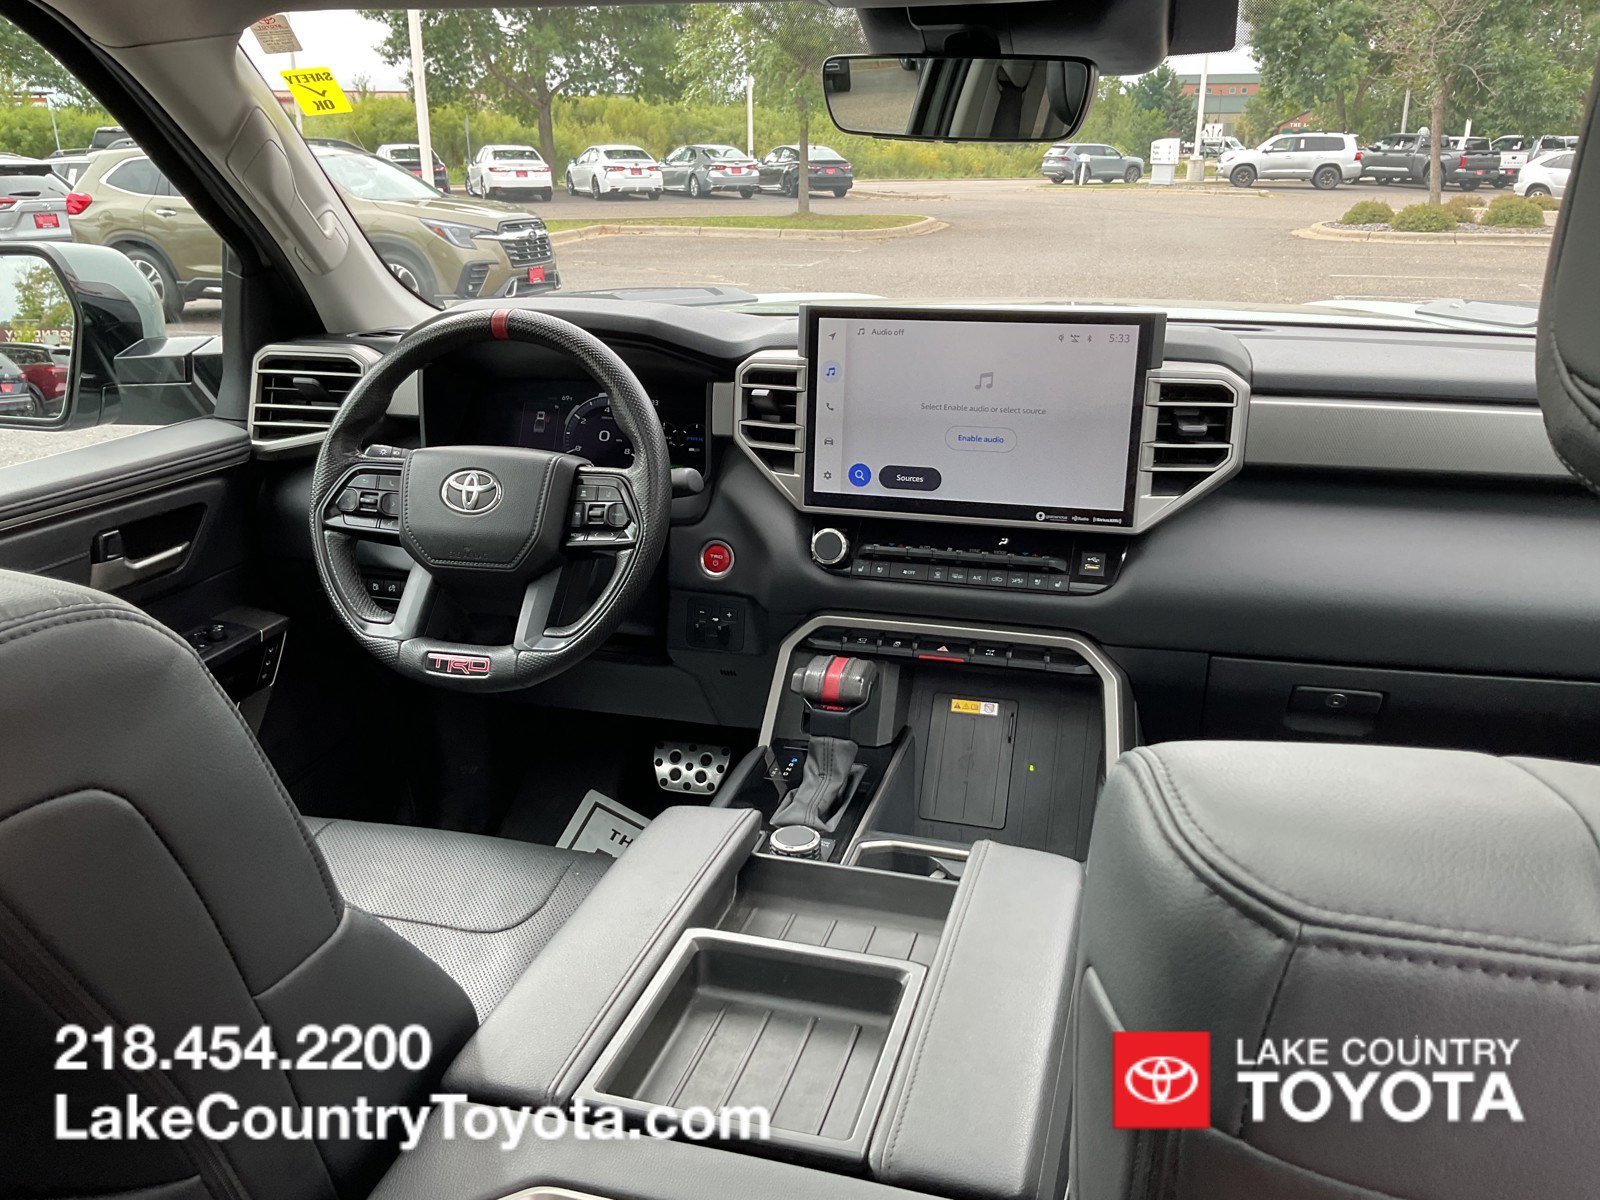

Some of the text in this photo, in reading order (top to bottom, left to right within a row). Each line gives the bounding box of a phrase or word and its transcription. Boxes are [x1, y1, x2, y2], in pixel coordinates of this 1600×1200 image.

[871, 328, 905, 336] Audio off
[1108, 333, 1131, 343] 5:33
[920, 402, 942, 411] Select
[943, 403, 968, 412] Enable
[969, 405, 989, 413] audio
[999, 406, 1021, 414] select
[958, 434, 1005, 444] Enable audio
[896, 474, 924, 483] Sources
[428, 652, 490, 674] TRD
